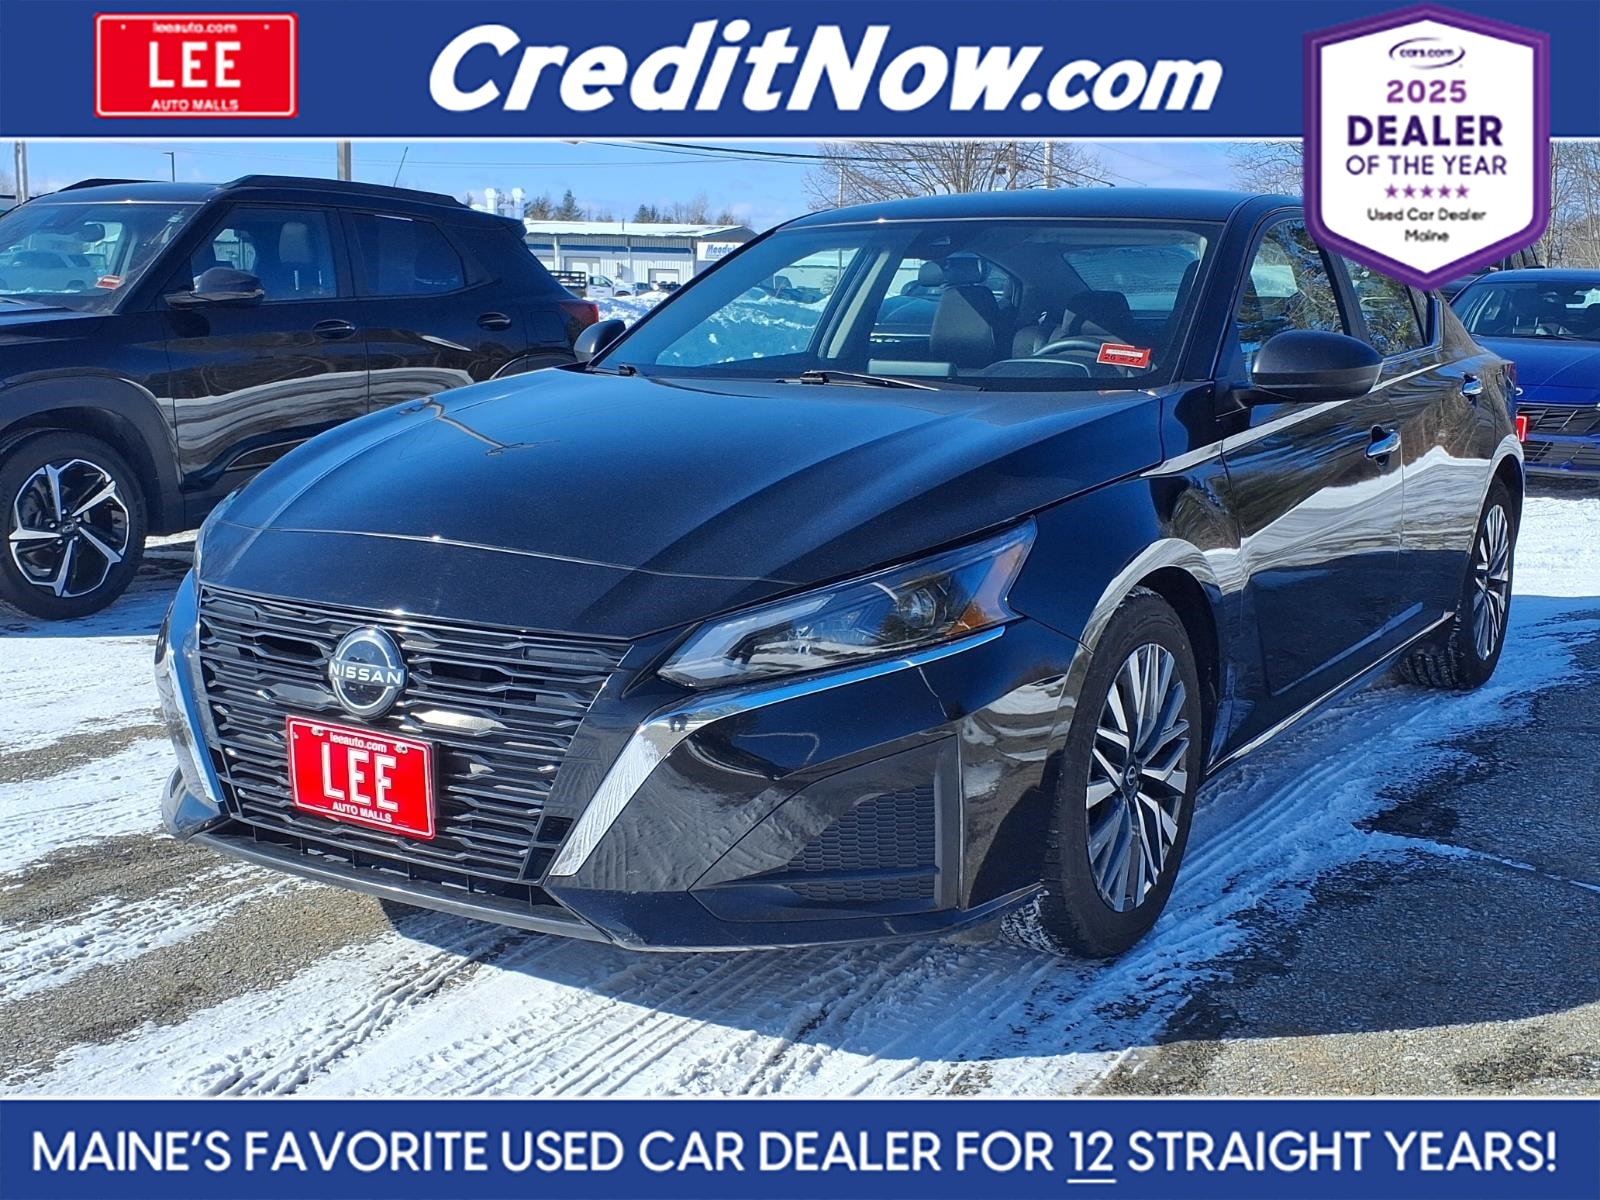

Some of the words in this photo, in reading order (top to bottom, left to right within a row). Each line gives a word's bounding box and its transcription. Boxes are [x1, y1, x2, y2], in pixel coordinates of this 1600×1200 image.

[329, 661, 402, 685] NISSAN
[329, 731, 388, 754] leeauto.com
[321, 742, 399, 813] LEE
[332, 801, 359, 815] AUTO
[359, 807, 392, 823] MALLS
